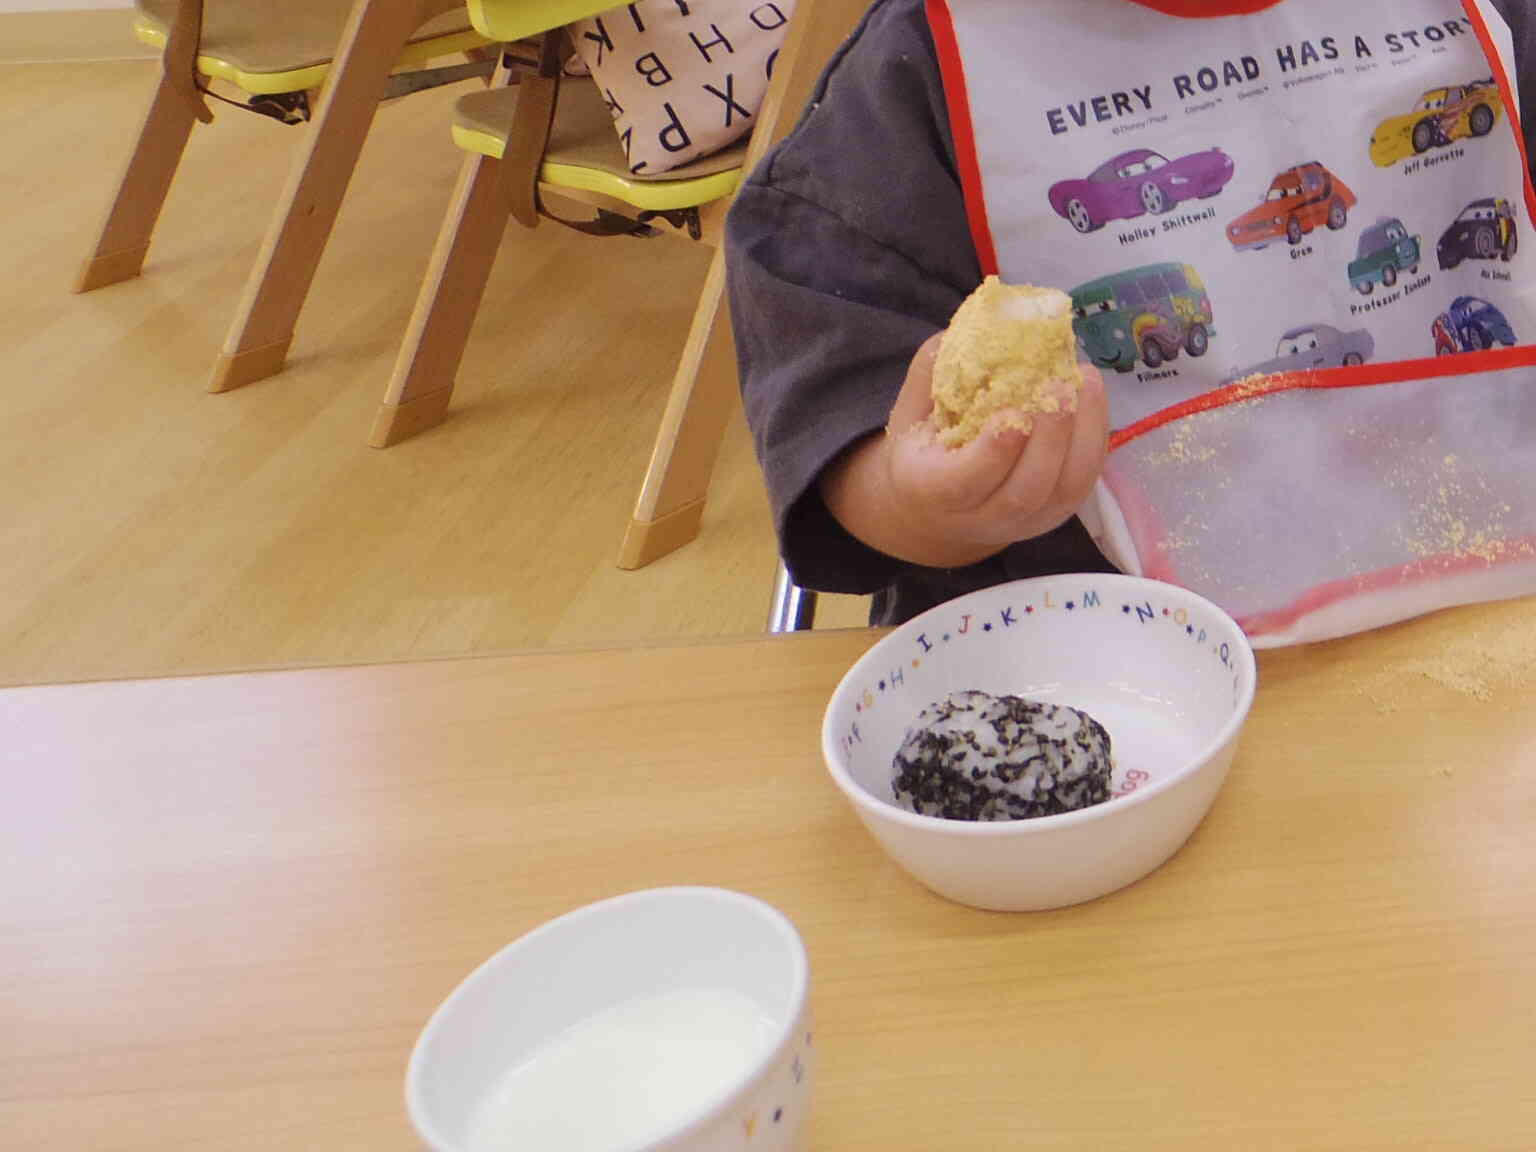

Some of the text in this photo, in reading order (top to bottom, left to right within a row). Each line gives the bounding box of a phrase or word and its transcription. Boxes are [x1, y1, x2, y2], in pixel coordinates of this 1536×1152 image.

[1045, 84, 1153, 136] EVERY
[1172, 55, 1261, 100] ROAD
[1275, 35, 1340, 73] HAS
[1353, 34, 1373, 59] A
[1384, 16, 1472, 53] STOR
